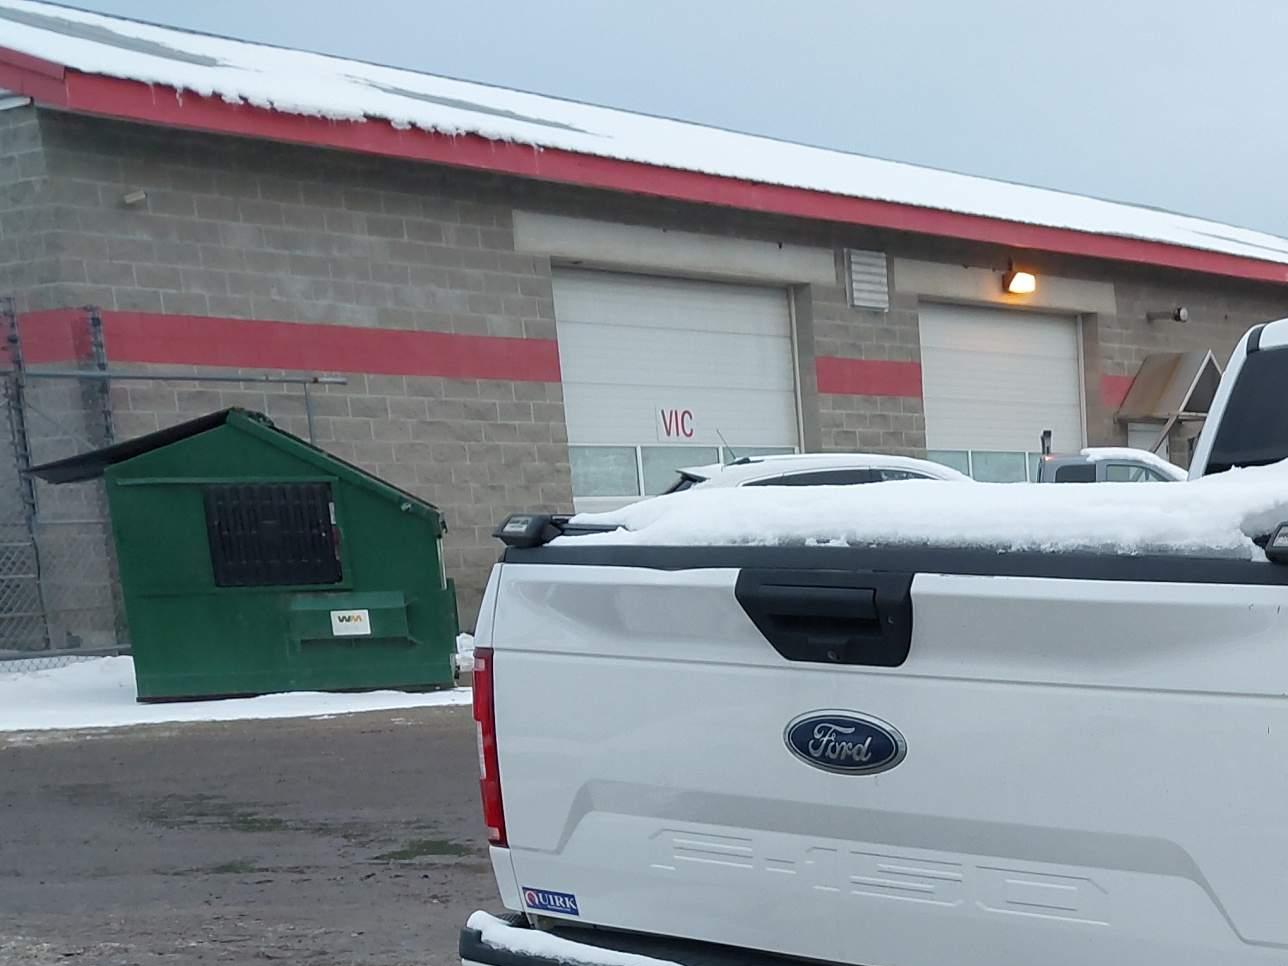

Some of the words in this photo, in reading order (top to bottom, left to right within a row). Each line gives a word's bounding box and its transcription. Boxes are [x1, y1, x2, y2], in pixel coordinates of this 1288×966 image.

[660, 409, 694, 438] VIC
[808, 723, 872, 761] Ford
[525, 890, 577, 910] QUIRK
